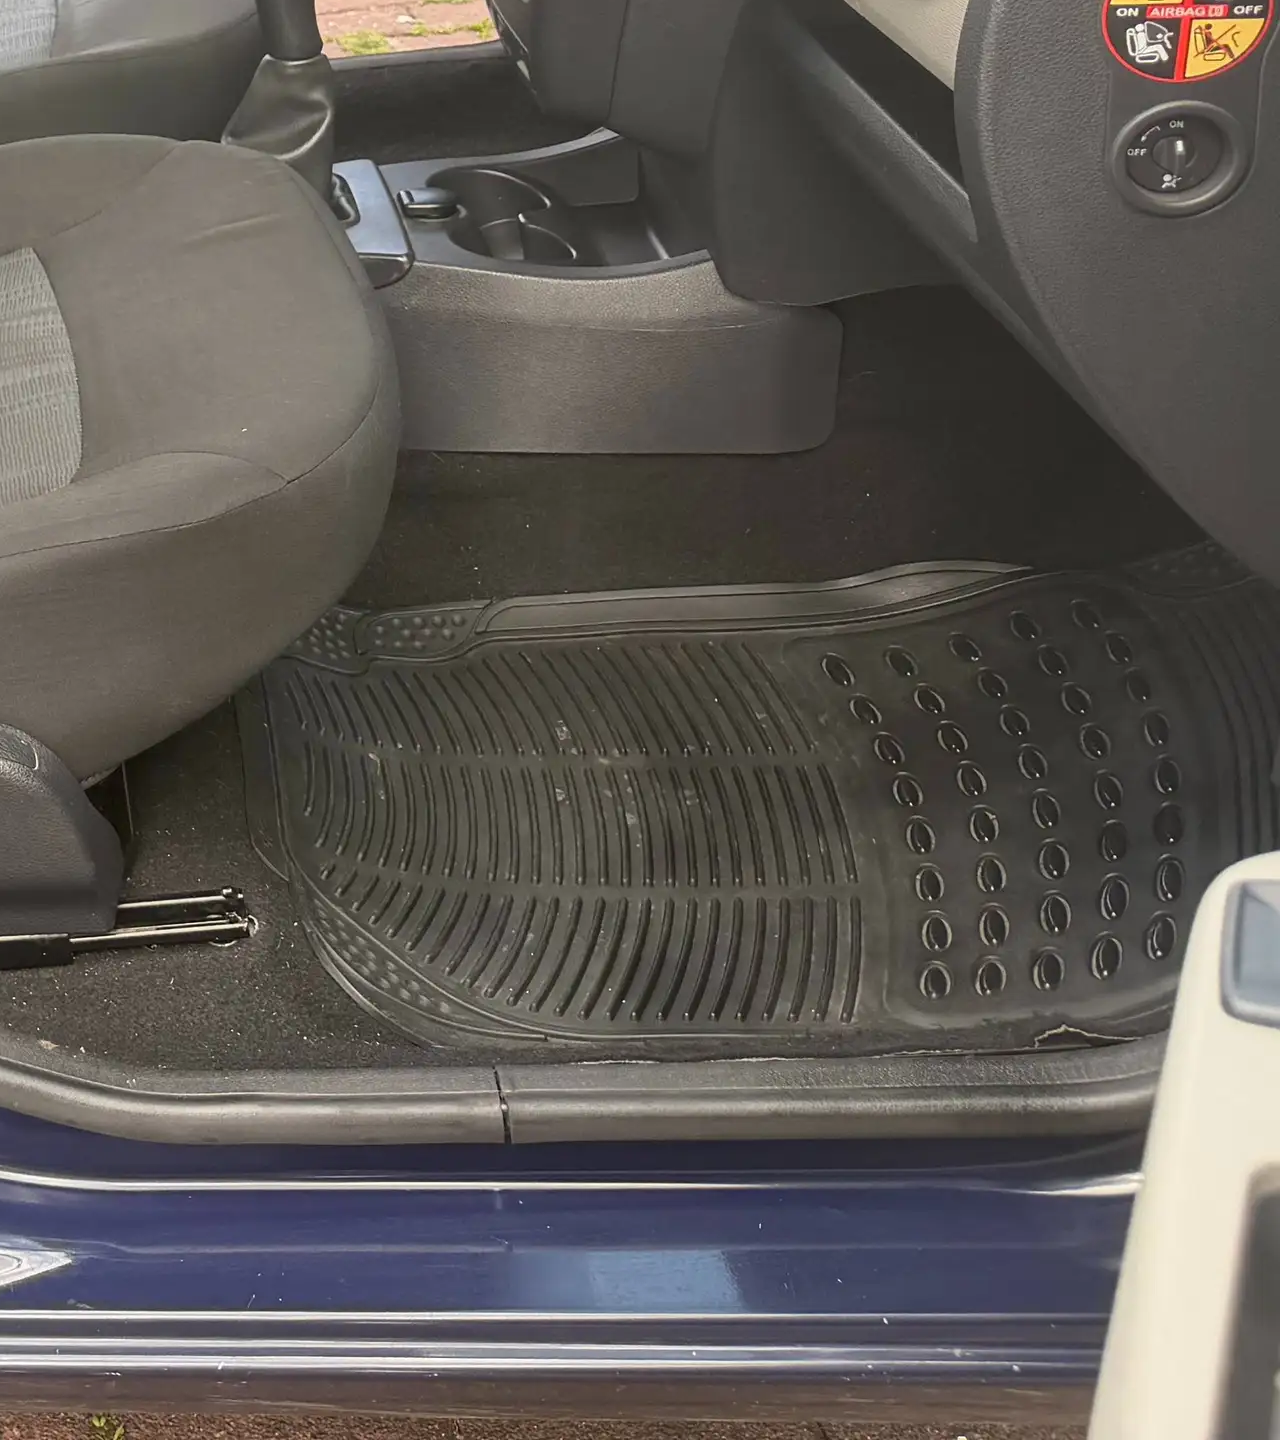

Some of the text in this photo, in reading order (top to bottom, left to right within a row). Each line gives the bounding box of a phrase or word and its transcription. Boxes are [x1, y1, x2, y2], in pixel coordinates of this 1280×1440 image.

[1116, 5, 1263, 17] ON AIRBAG OFF
[1169, 120, 1184, 128] ON
[1127, 148, 1147, 156] OFF
